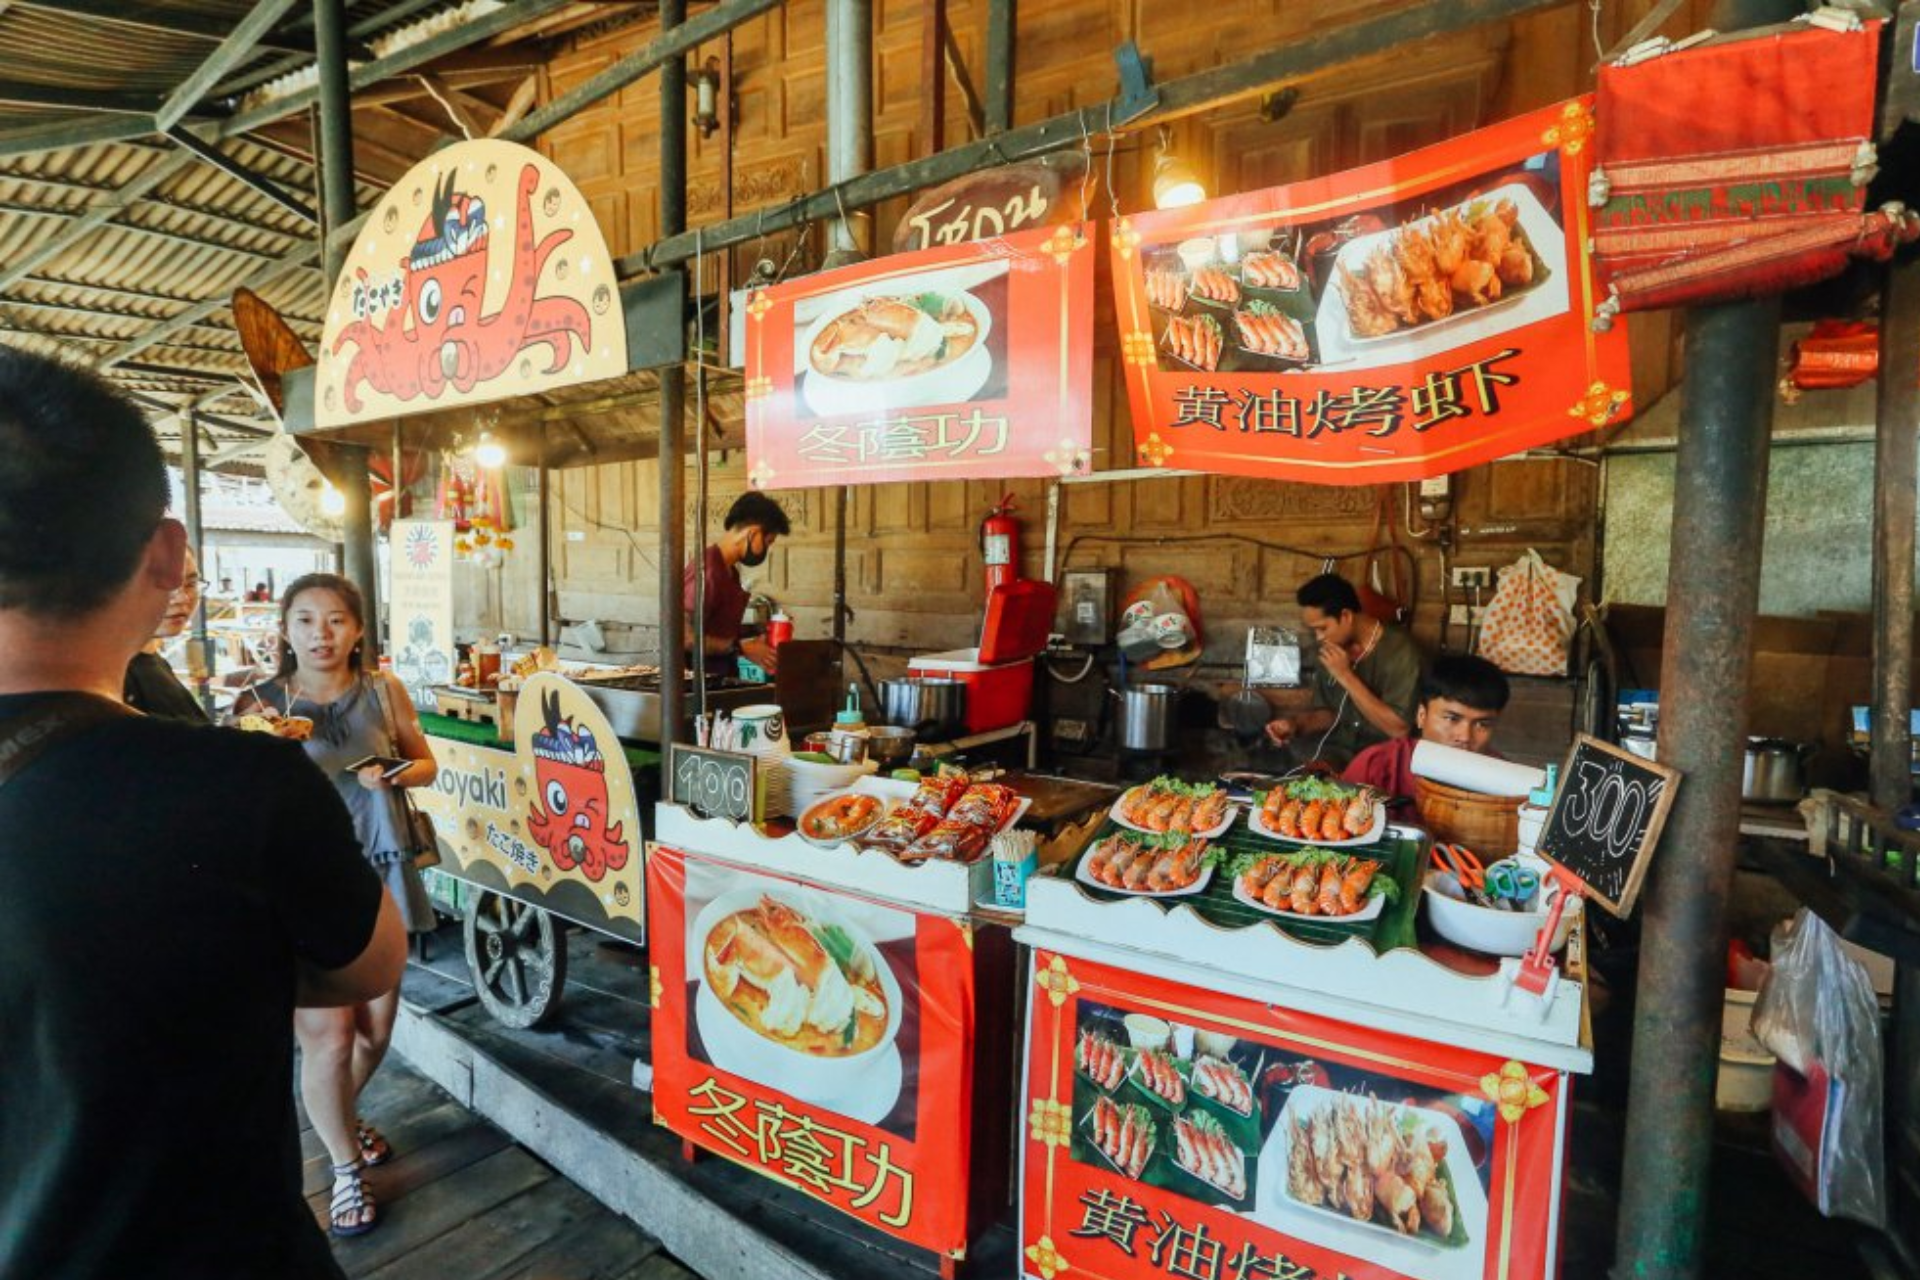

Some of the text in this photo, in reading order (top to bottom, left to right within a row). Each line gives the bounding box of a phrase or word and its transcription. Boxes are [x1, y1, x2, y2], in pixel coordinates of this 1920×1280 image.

[797, 408, 1010, 464] 冬蔭功
[1169, 347, 1522, 438] 黄油烤虾
[678, 754, 750, 819] 100
[1562, 760, 1646, 858] 300
[486, 823, 539, 874] たこ焼き
[687, 1077, 914, 1228] 冬蔭功
[1069, 1187, 1354, 1280] 黄油烤
